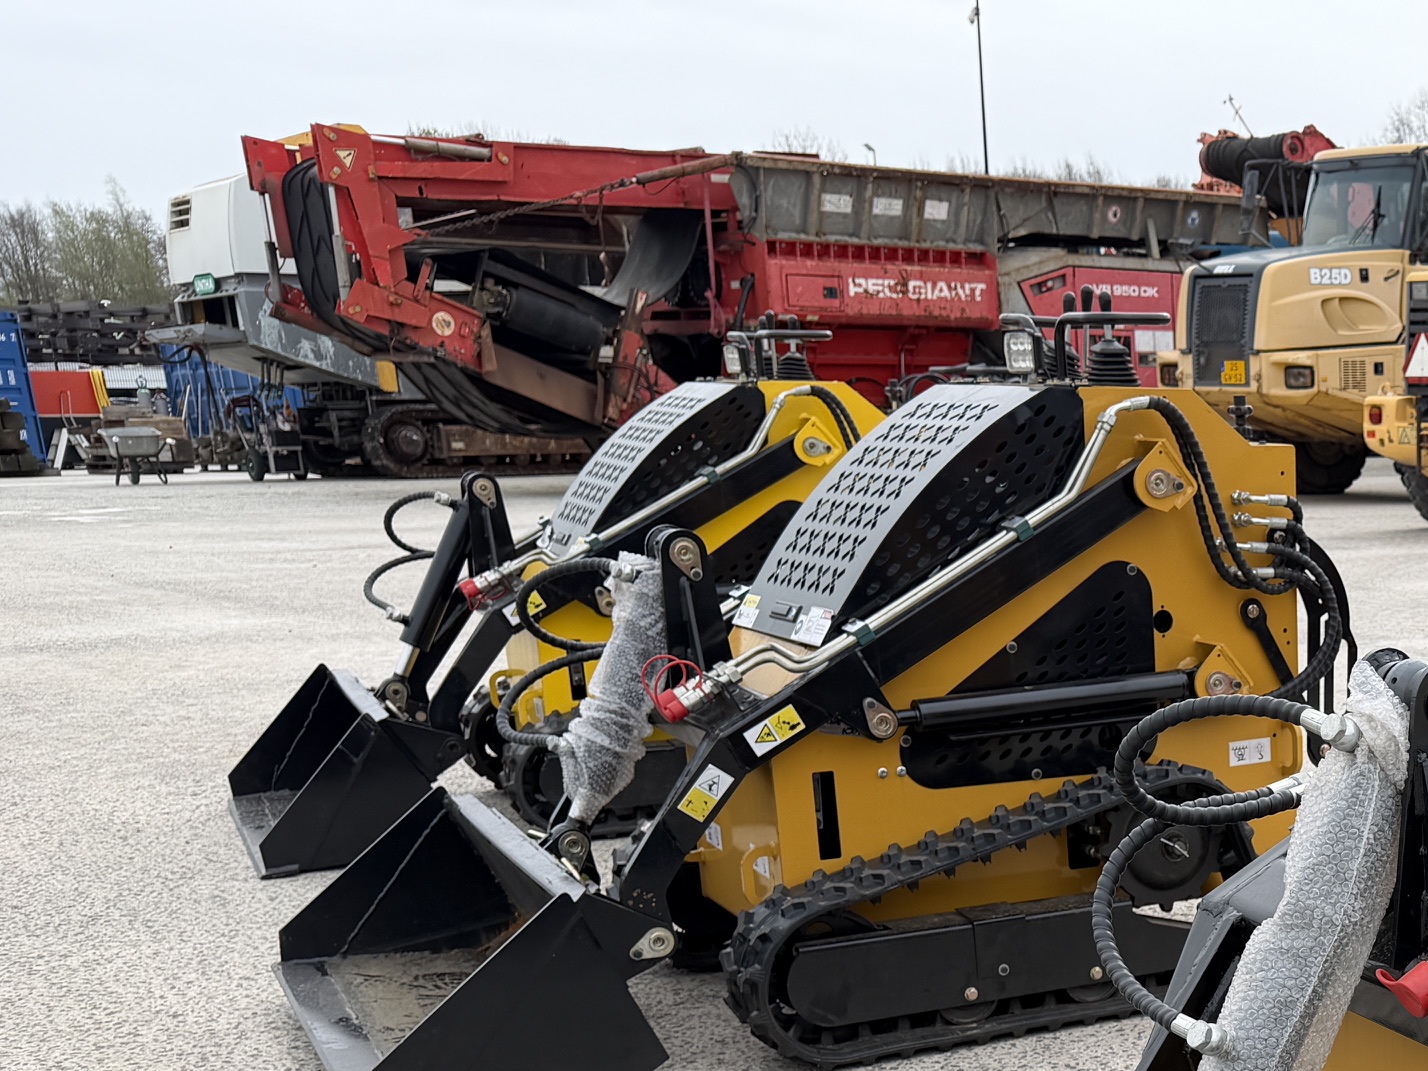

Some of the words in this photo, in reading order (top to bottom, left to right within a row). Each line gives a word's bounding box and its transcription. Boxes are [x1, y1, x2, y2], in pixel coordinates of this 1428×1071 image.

[1309, 267, 1352, 285] B25D
[908, 280, 987, 302] GIANT
[1140, 285, 1159, 298] DK
